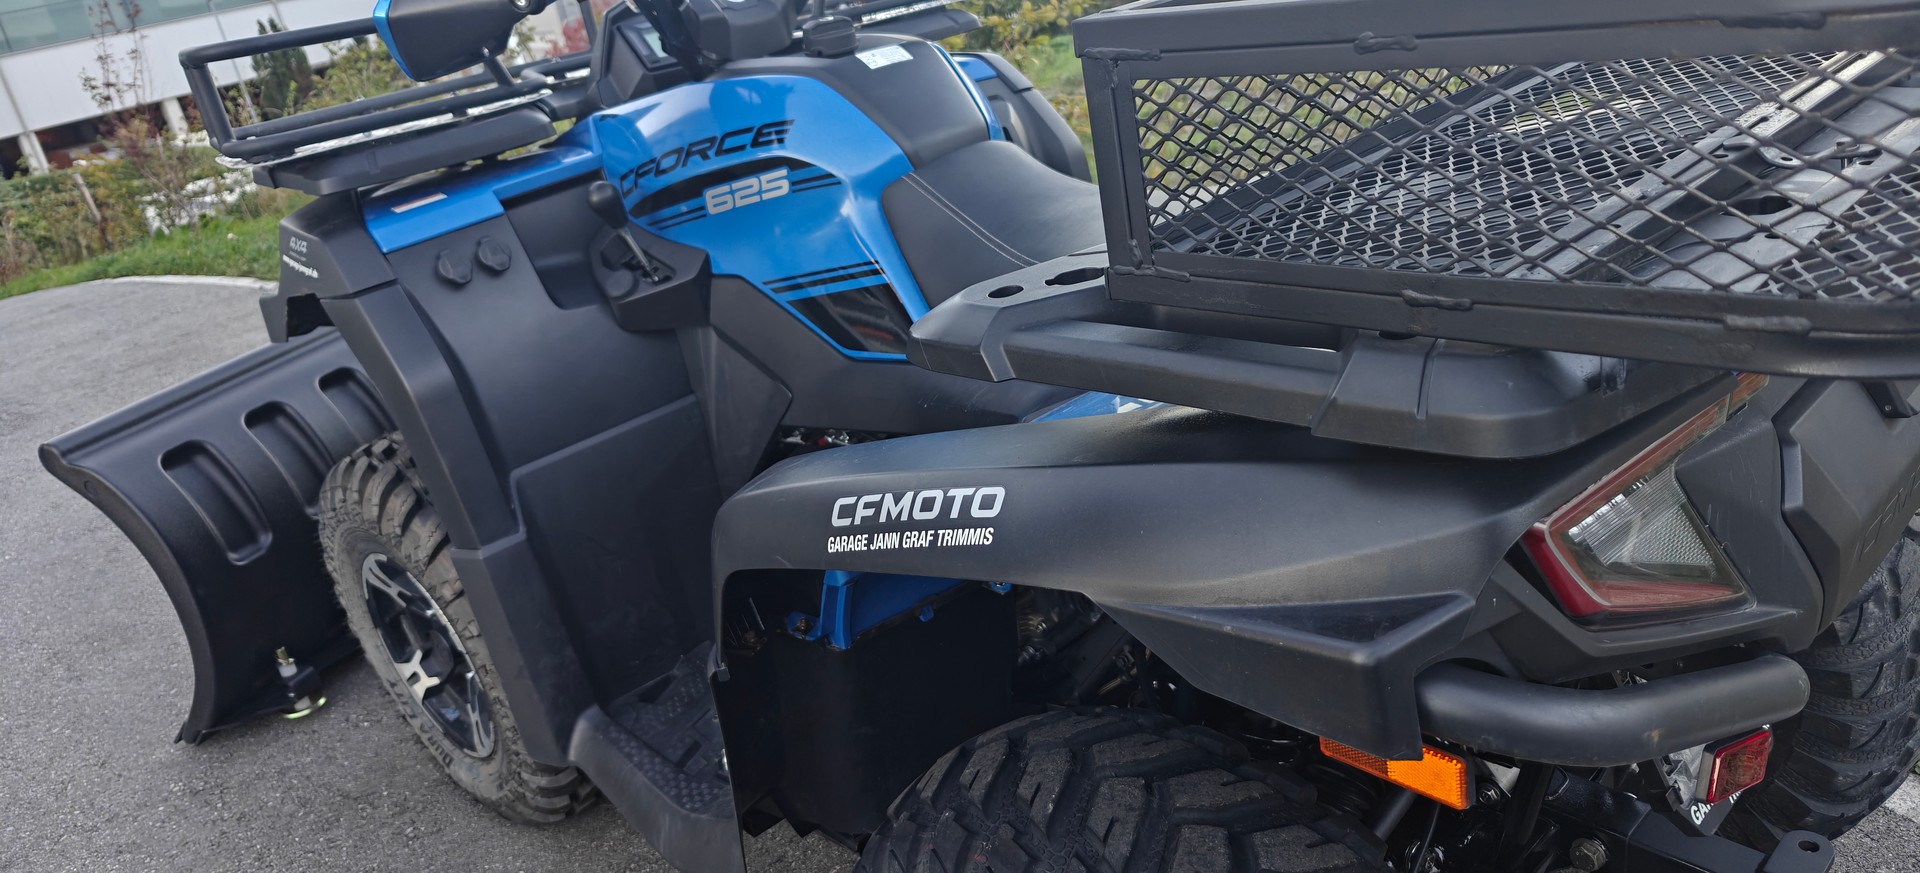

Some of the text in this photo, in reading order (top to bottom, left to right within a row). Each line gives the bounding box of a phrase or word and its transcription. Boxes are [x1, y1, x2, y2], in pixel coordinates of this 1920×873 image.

[620, 119, 795, 198] CFORCE
[706, 169, 790, 215] 625
[831, 486, 1006, 527] CFMOTO
[827, 527, 994, 553] GARAGE JANN GRAF TRIMMIS
